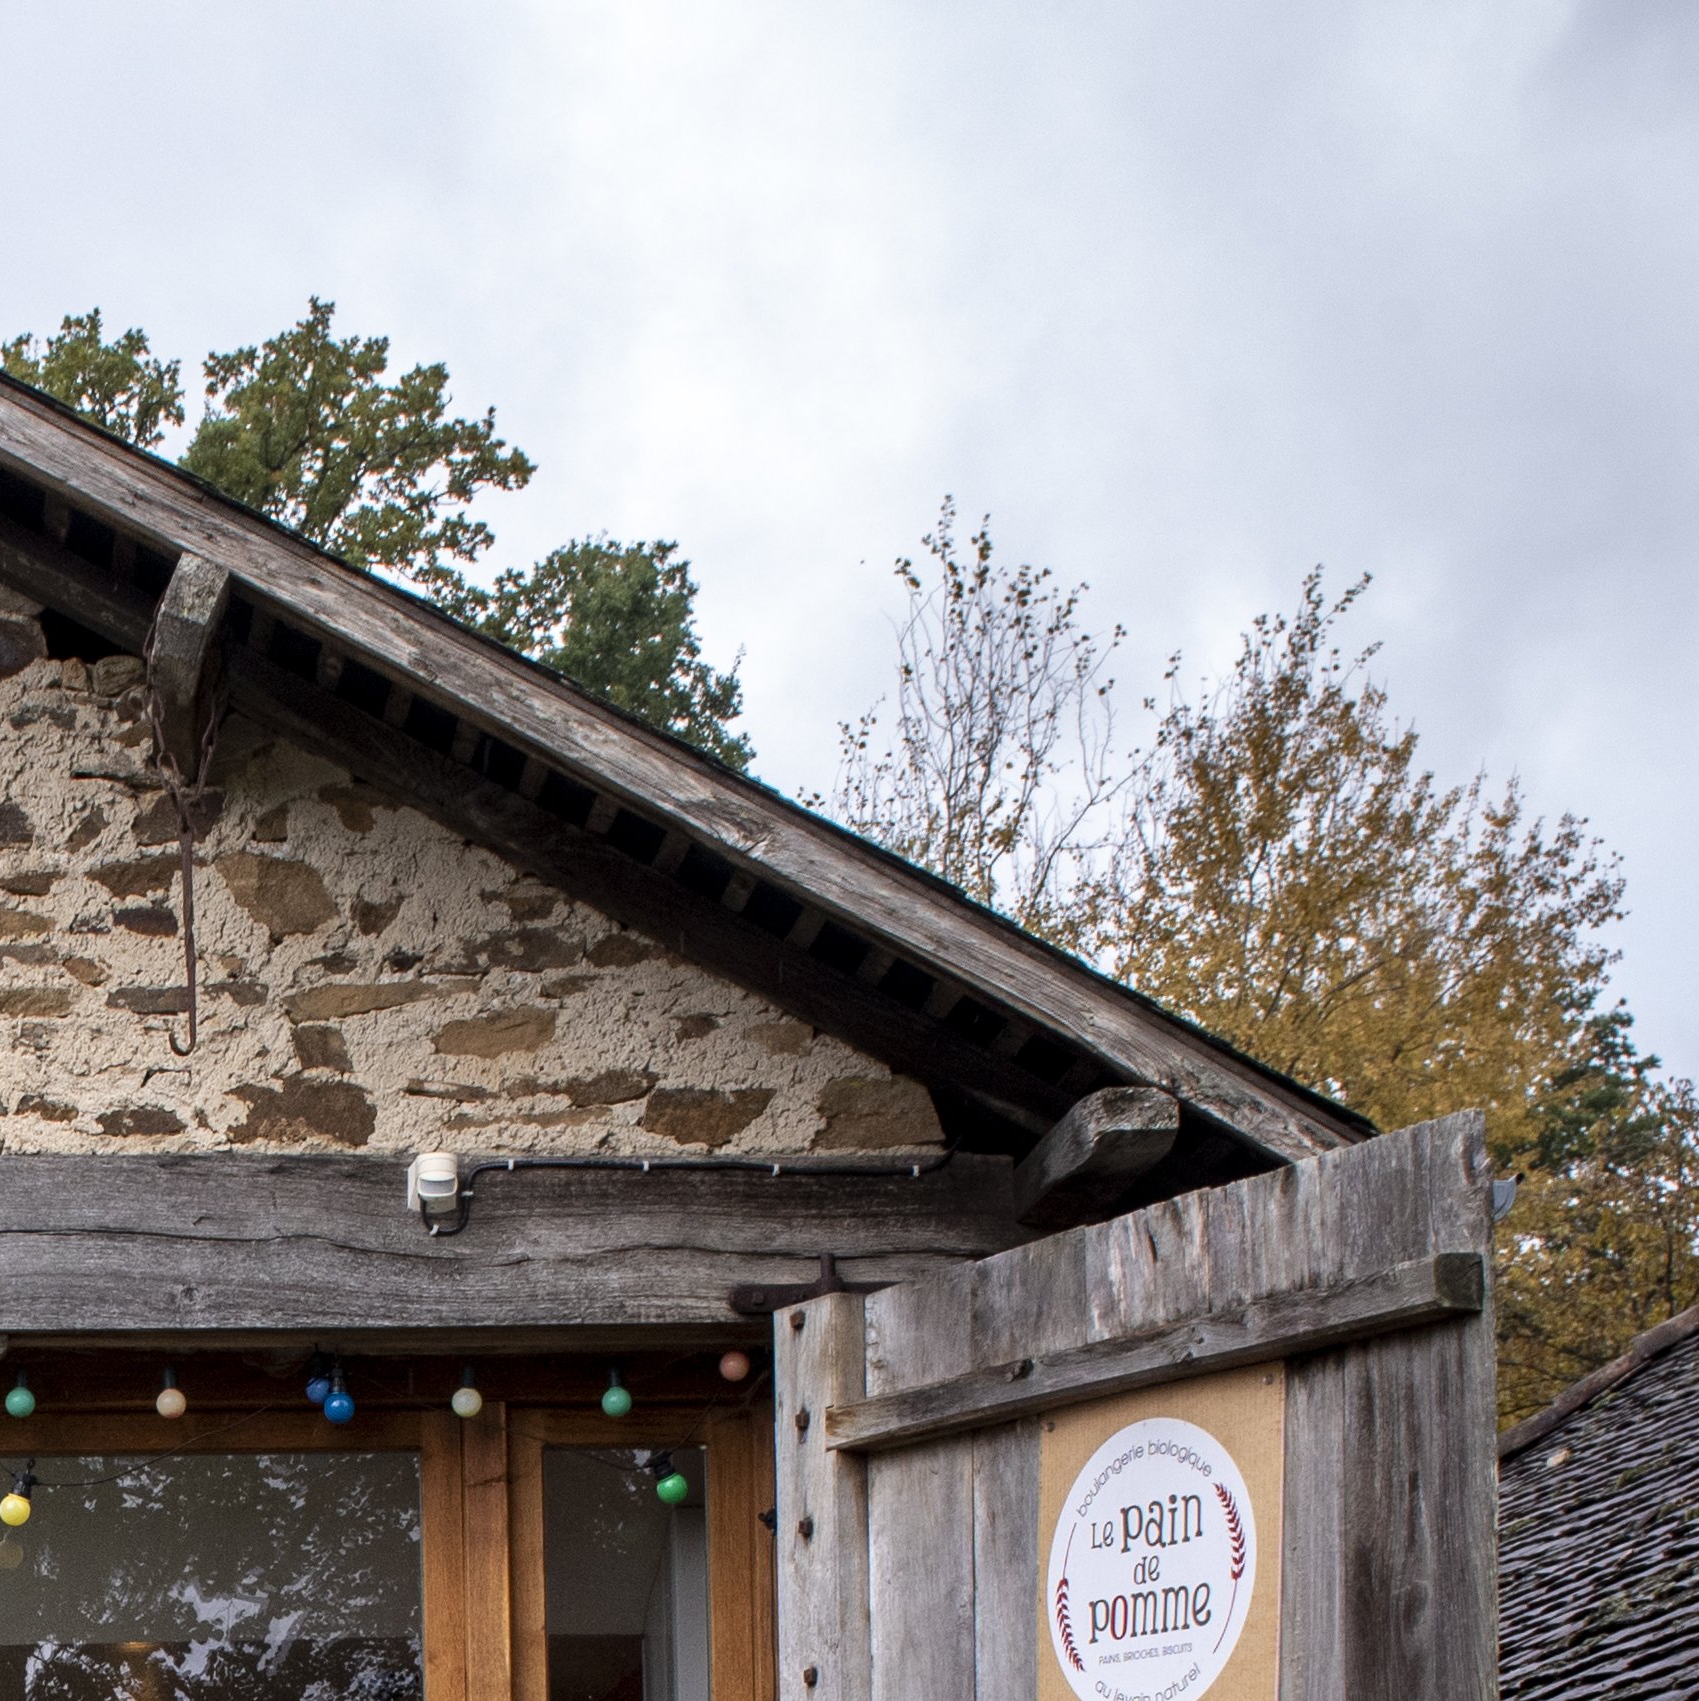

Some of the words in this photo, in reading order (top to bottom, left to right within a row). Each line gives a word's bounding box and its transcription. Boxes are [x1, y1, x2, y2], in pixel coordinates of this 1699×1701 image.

[1076, 1444, 1144, 1517] boulangerie
[1148, 1439, 1211, 1477] biologique
[1090, 1520, 1114, 1550] Le
[1120, 1493, 1203, 1553] pain
[1133, 1555, 1160, 1585] de
[1088, 1582, 1212, 1644] pomme
[1095, 1680, 1112, 1699] au
